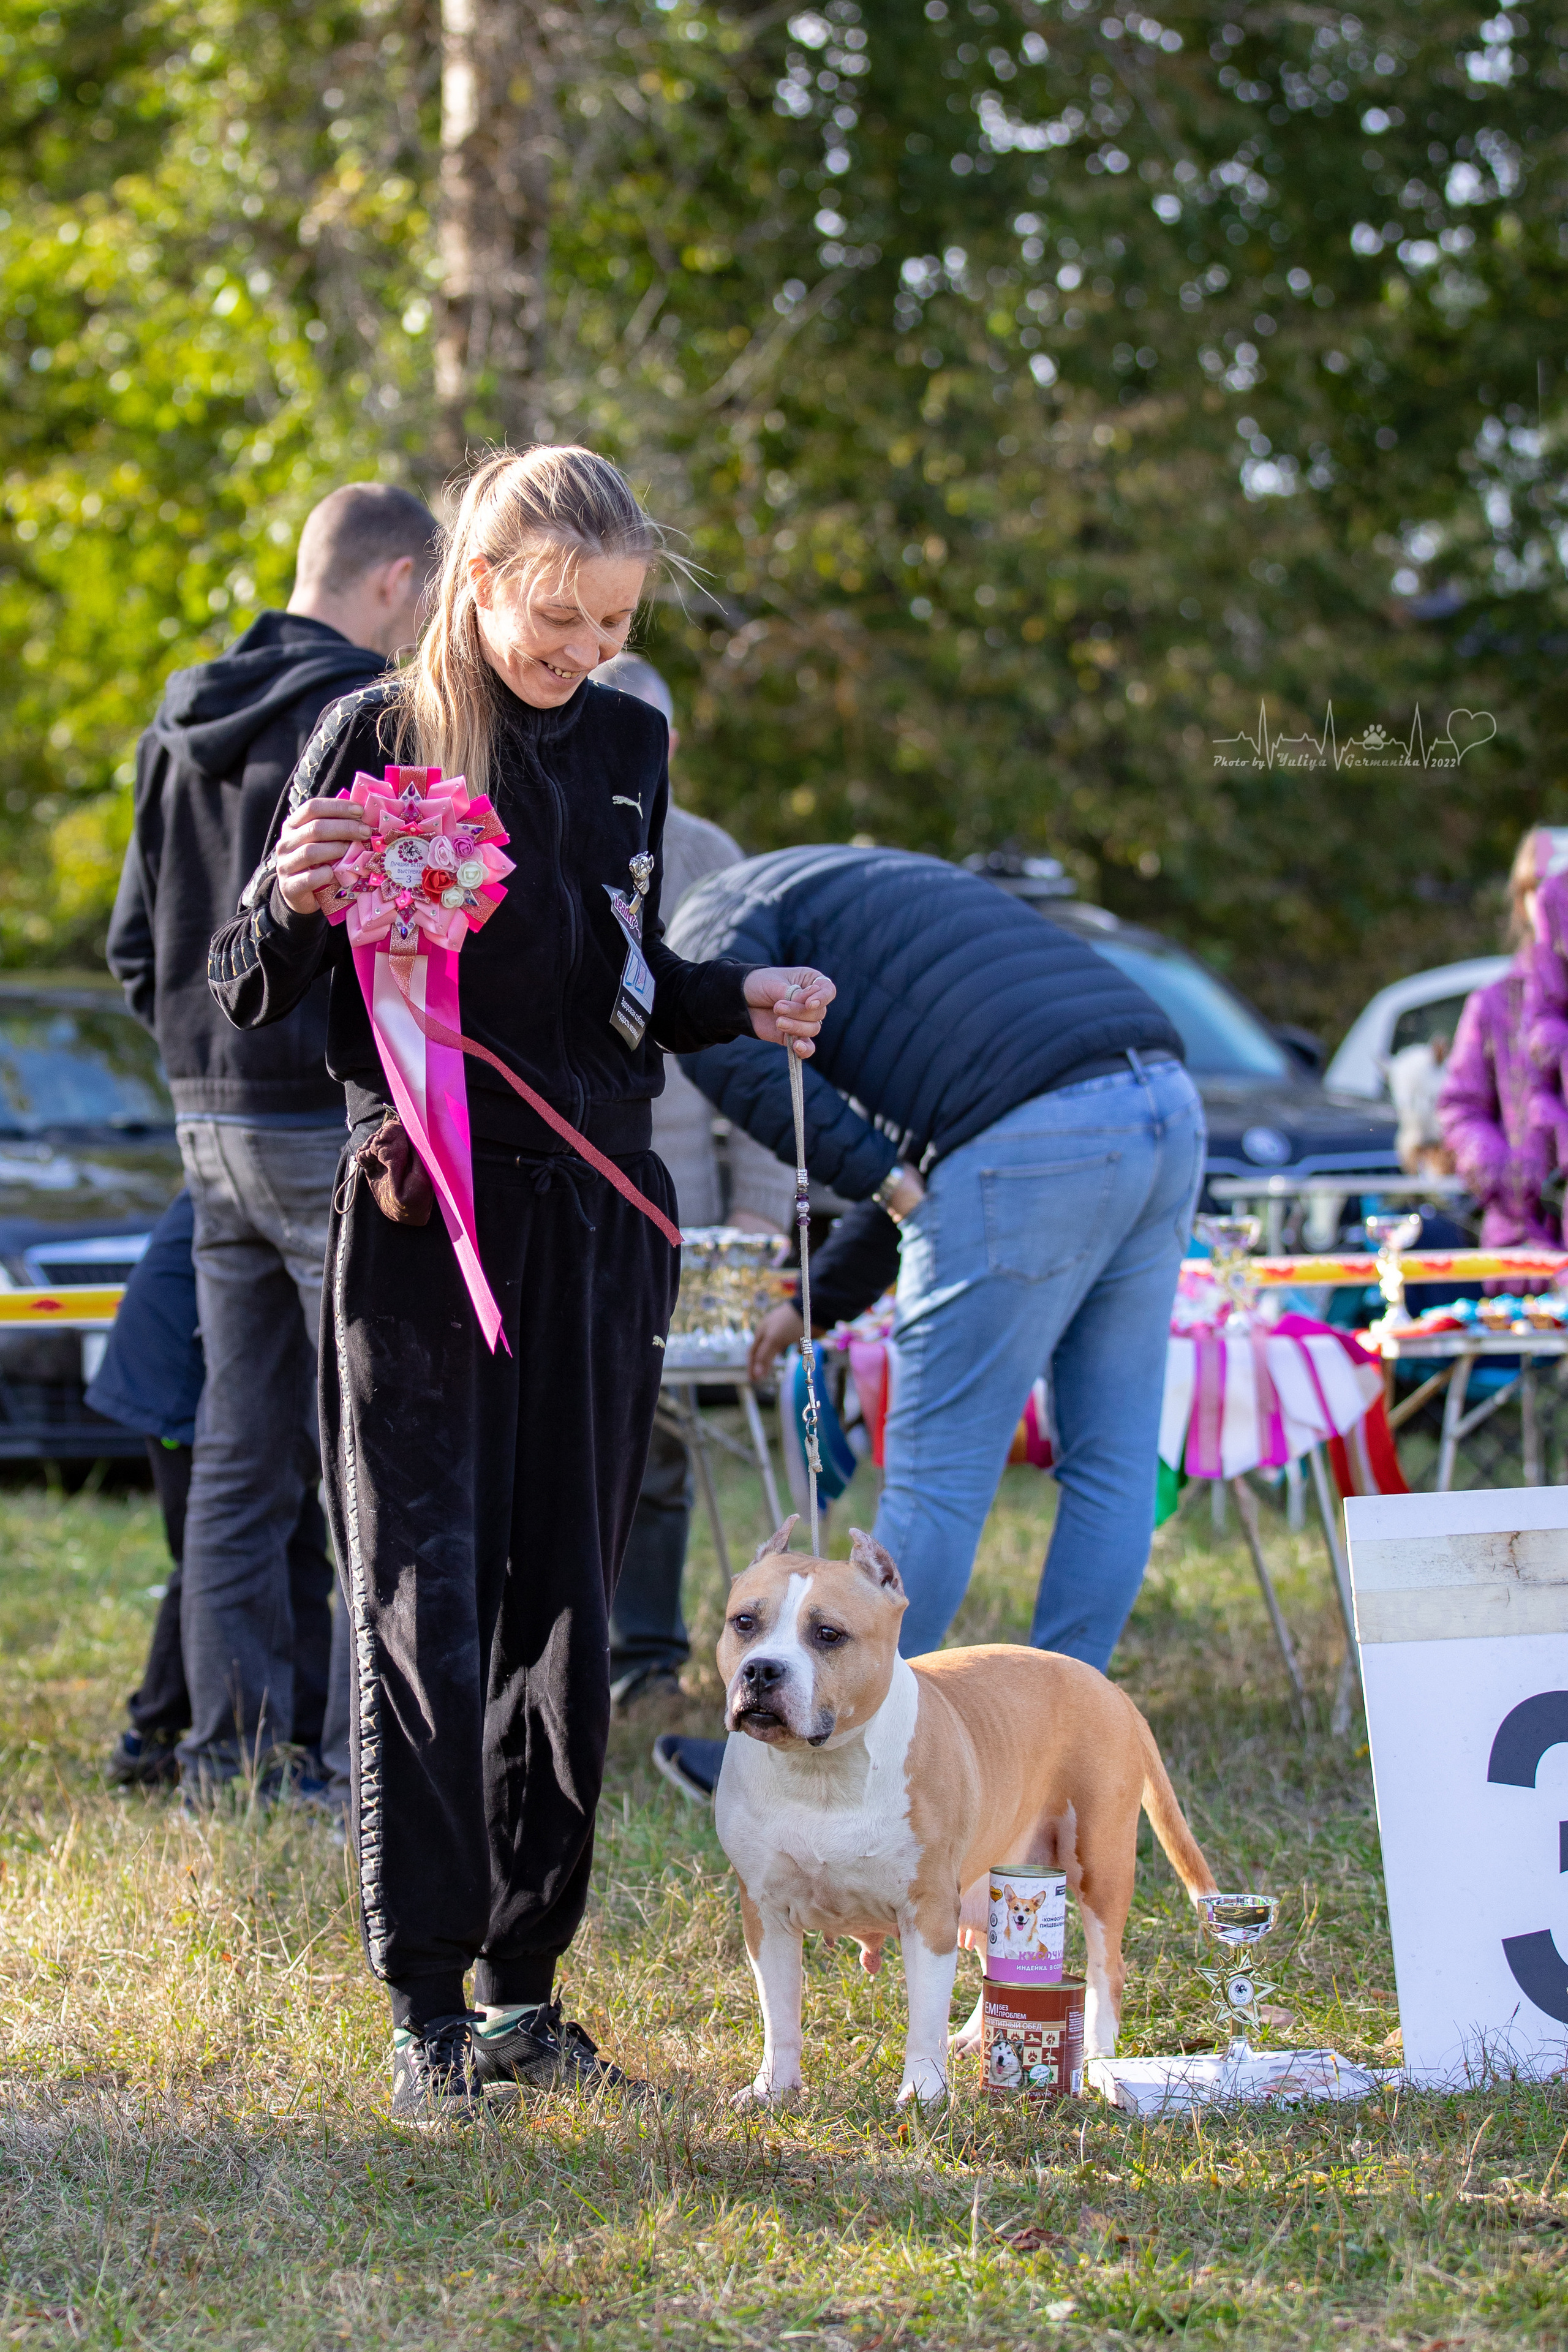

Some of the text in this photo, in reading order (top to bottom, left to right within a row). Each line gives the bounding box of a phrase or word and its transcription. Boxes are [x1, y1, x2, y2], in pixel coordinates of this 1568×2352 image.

[405, 875, 412, 883] 3
[998, 2011, 1027, 2019] ПРОБЛЕМ
[1022, 2022, 1042, 2031] ОБЕД
